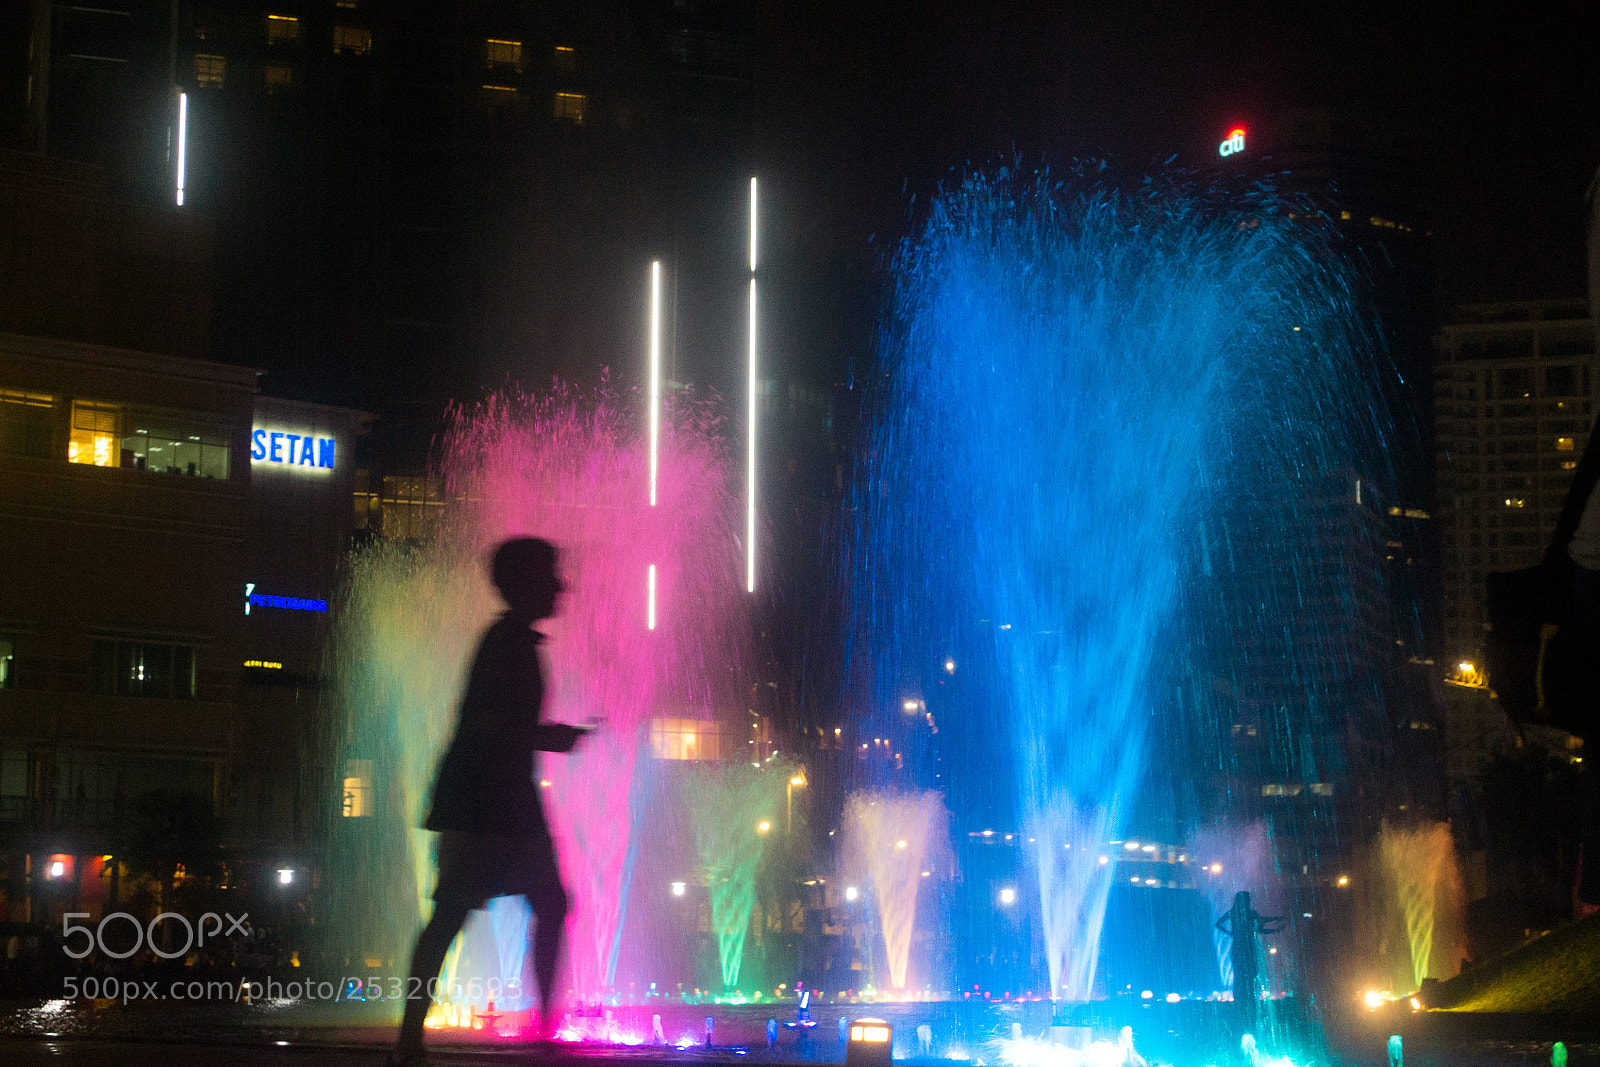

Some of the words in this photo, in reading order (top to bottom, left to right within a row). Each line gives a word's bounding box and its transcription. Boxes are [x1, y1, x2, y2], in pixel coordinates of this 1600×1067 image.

[1219, 132, 1244, 157] citi
[251, 428, 335, 469] SETAN
[249, 593, 328, 612] PETROSAINS
